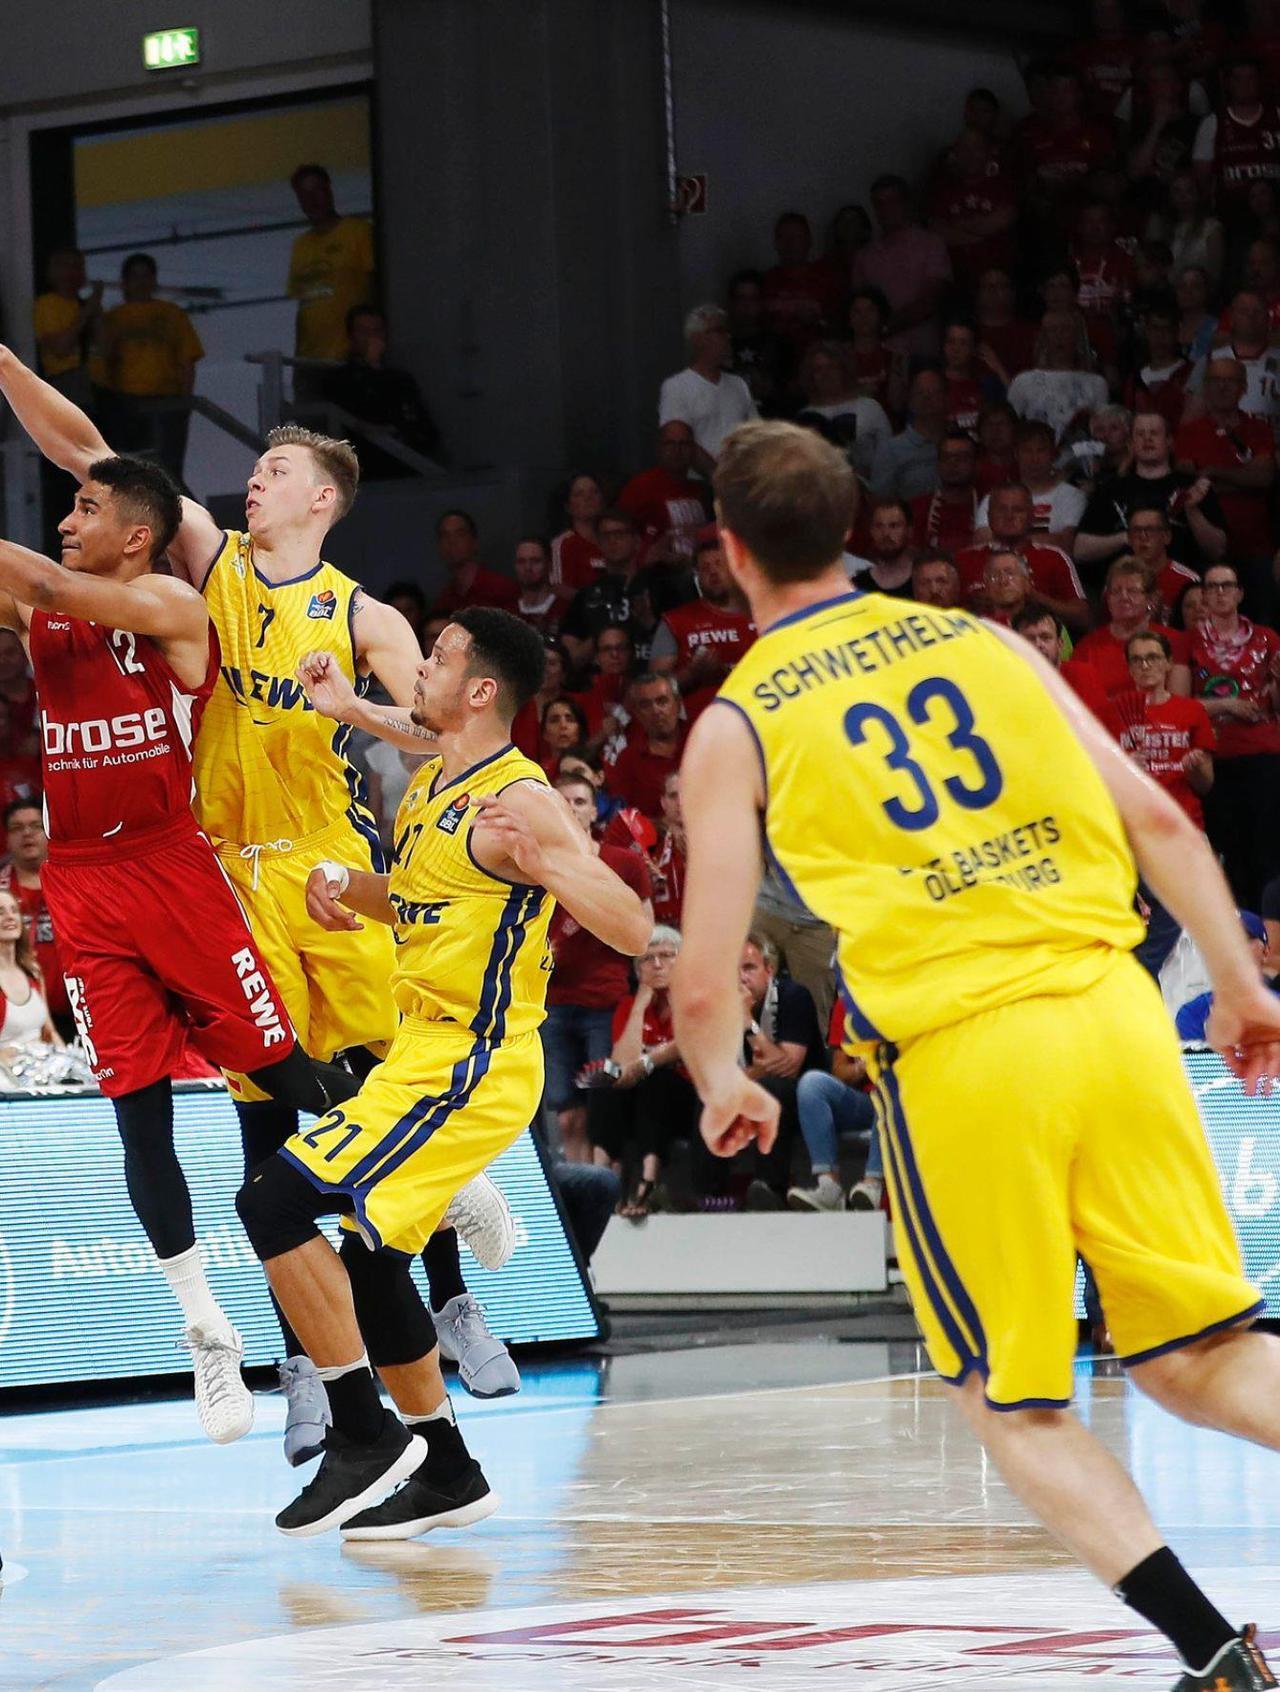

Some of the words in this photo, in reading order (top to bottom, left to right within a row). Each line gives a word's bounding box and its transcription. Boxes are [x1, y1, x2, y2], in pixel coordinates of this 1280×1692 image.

[256, 603, 276, 648] 7
[688, 630, 739, 648] REWE
[105, 628, 145, 676] 2
[753, 614, 979, 712] SCHWETHELM
[42, 707, 168, 755] brose
[843, 677, 1004, 832] 33
[48, 756, 81, 772] echnik
[82, 757, 99, 769] für
[102, 743, 170, 767] Automobile
[952, 816, 1061, 877] BASKETS
[231, 946, 287, 1048] REWE
[303, 1110, 363, 1162] 21
